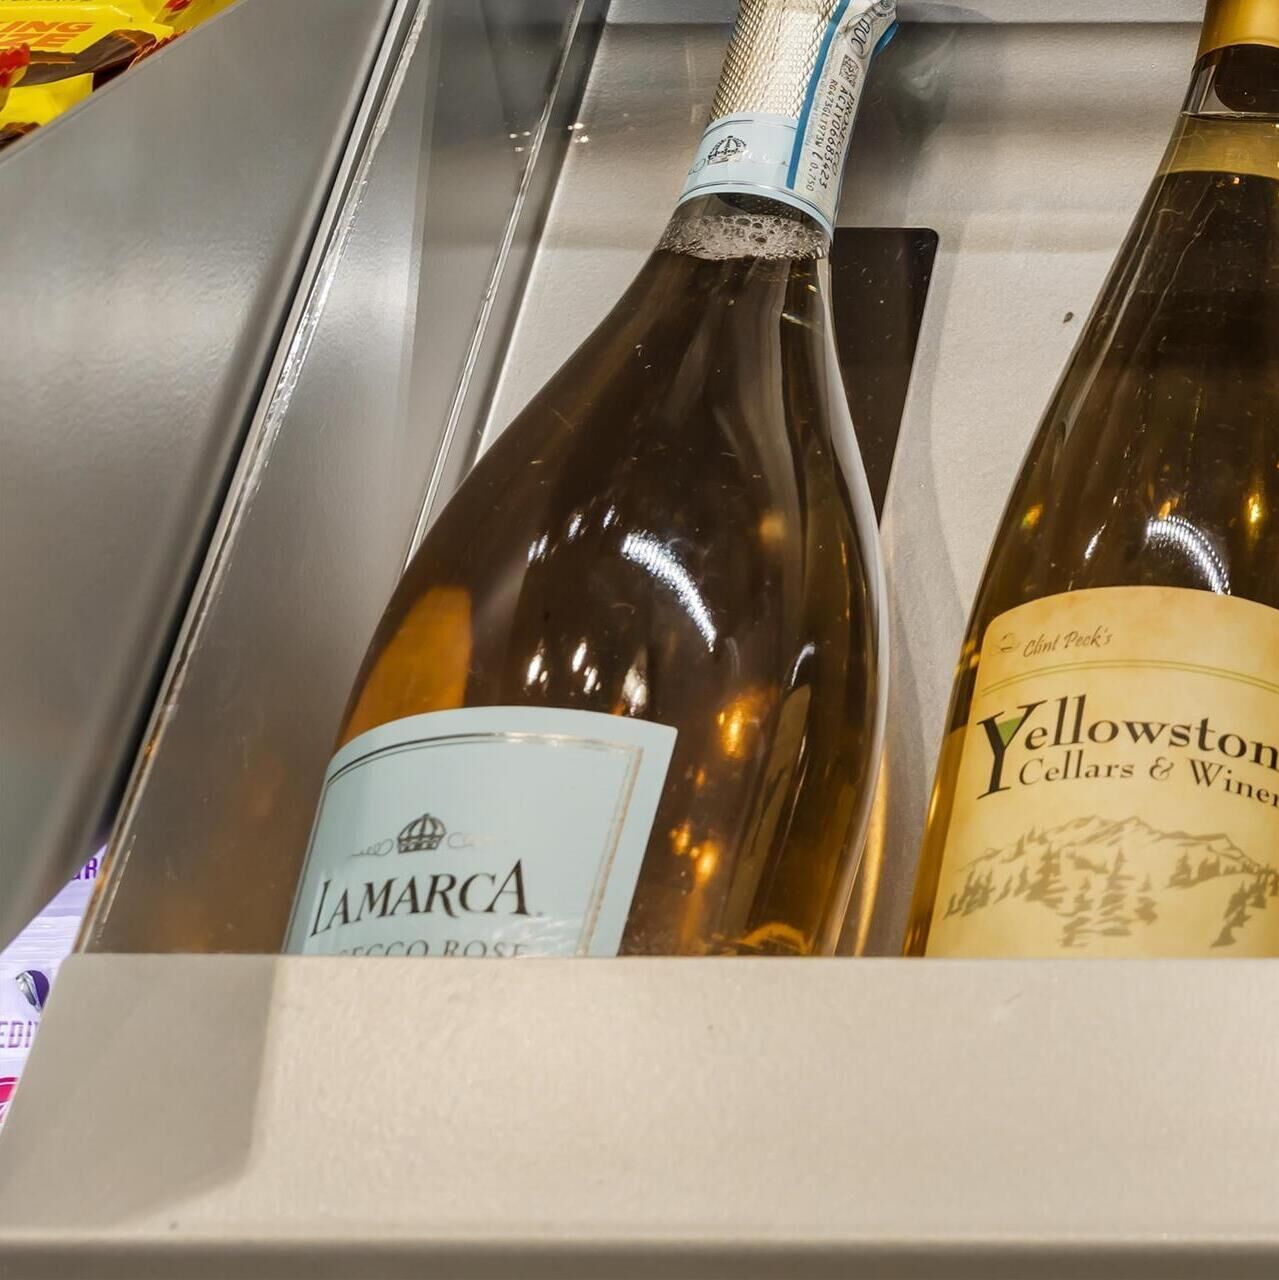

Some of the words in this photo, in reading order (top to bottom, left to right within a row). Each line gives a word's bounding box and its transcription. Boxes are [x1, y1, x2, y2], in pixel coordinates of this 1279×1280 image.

[0, 21, 95, 33] ING
[1019, 750, 1135, 786] Cellars
[1149, 756, 1175, 781] &
